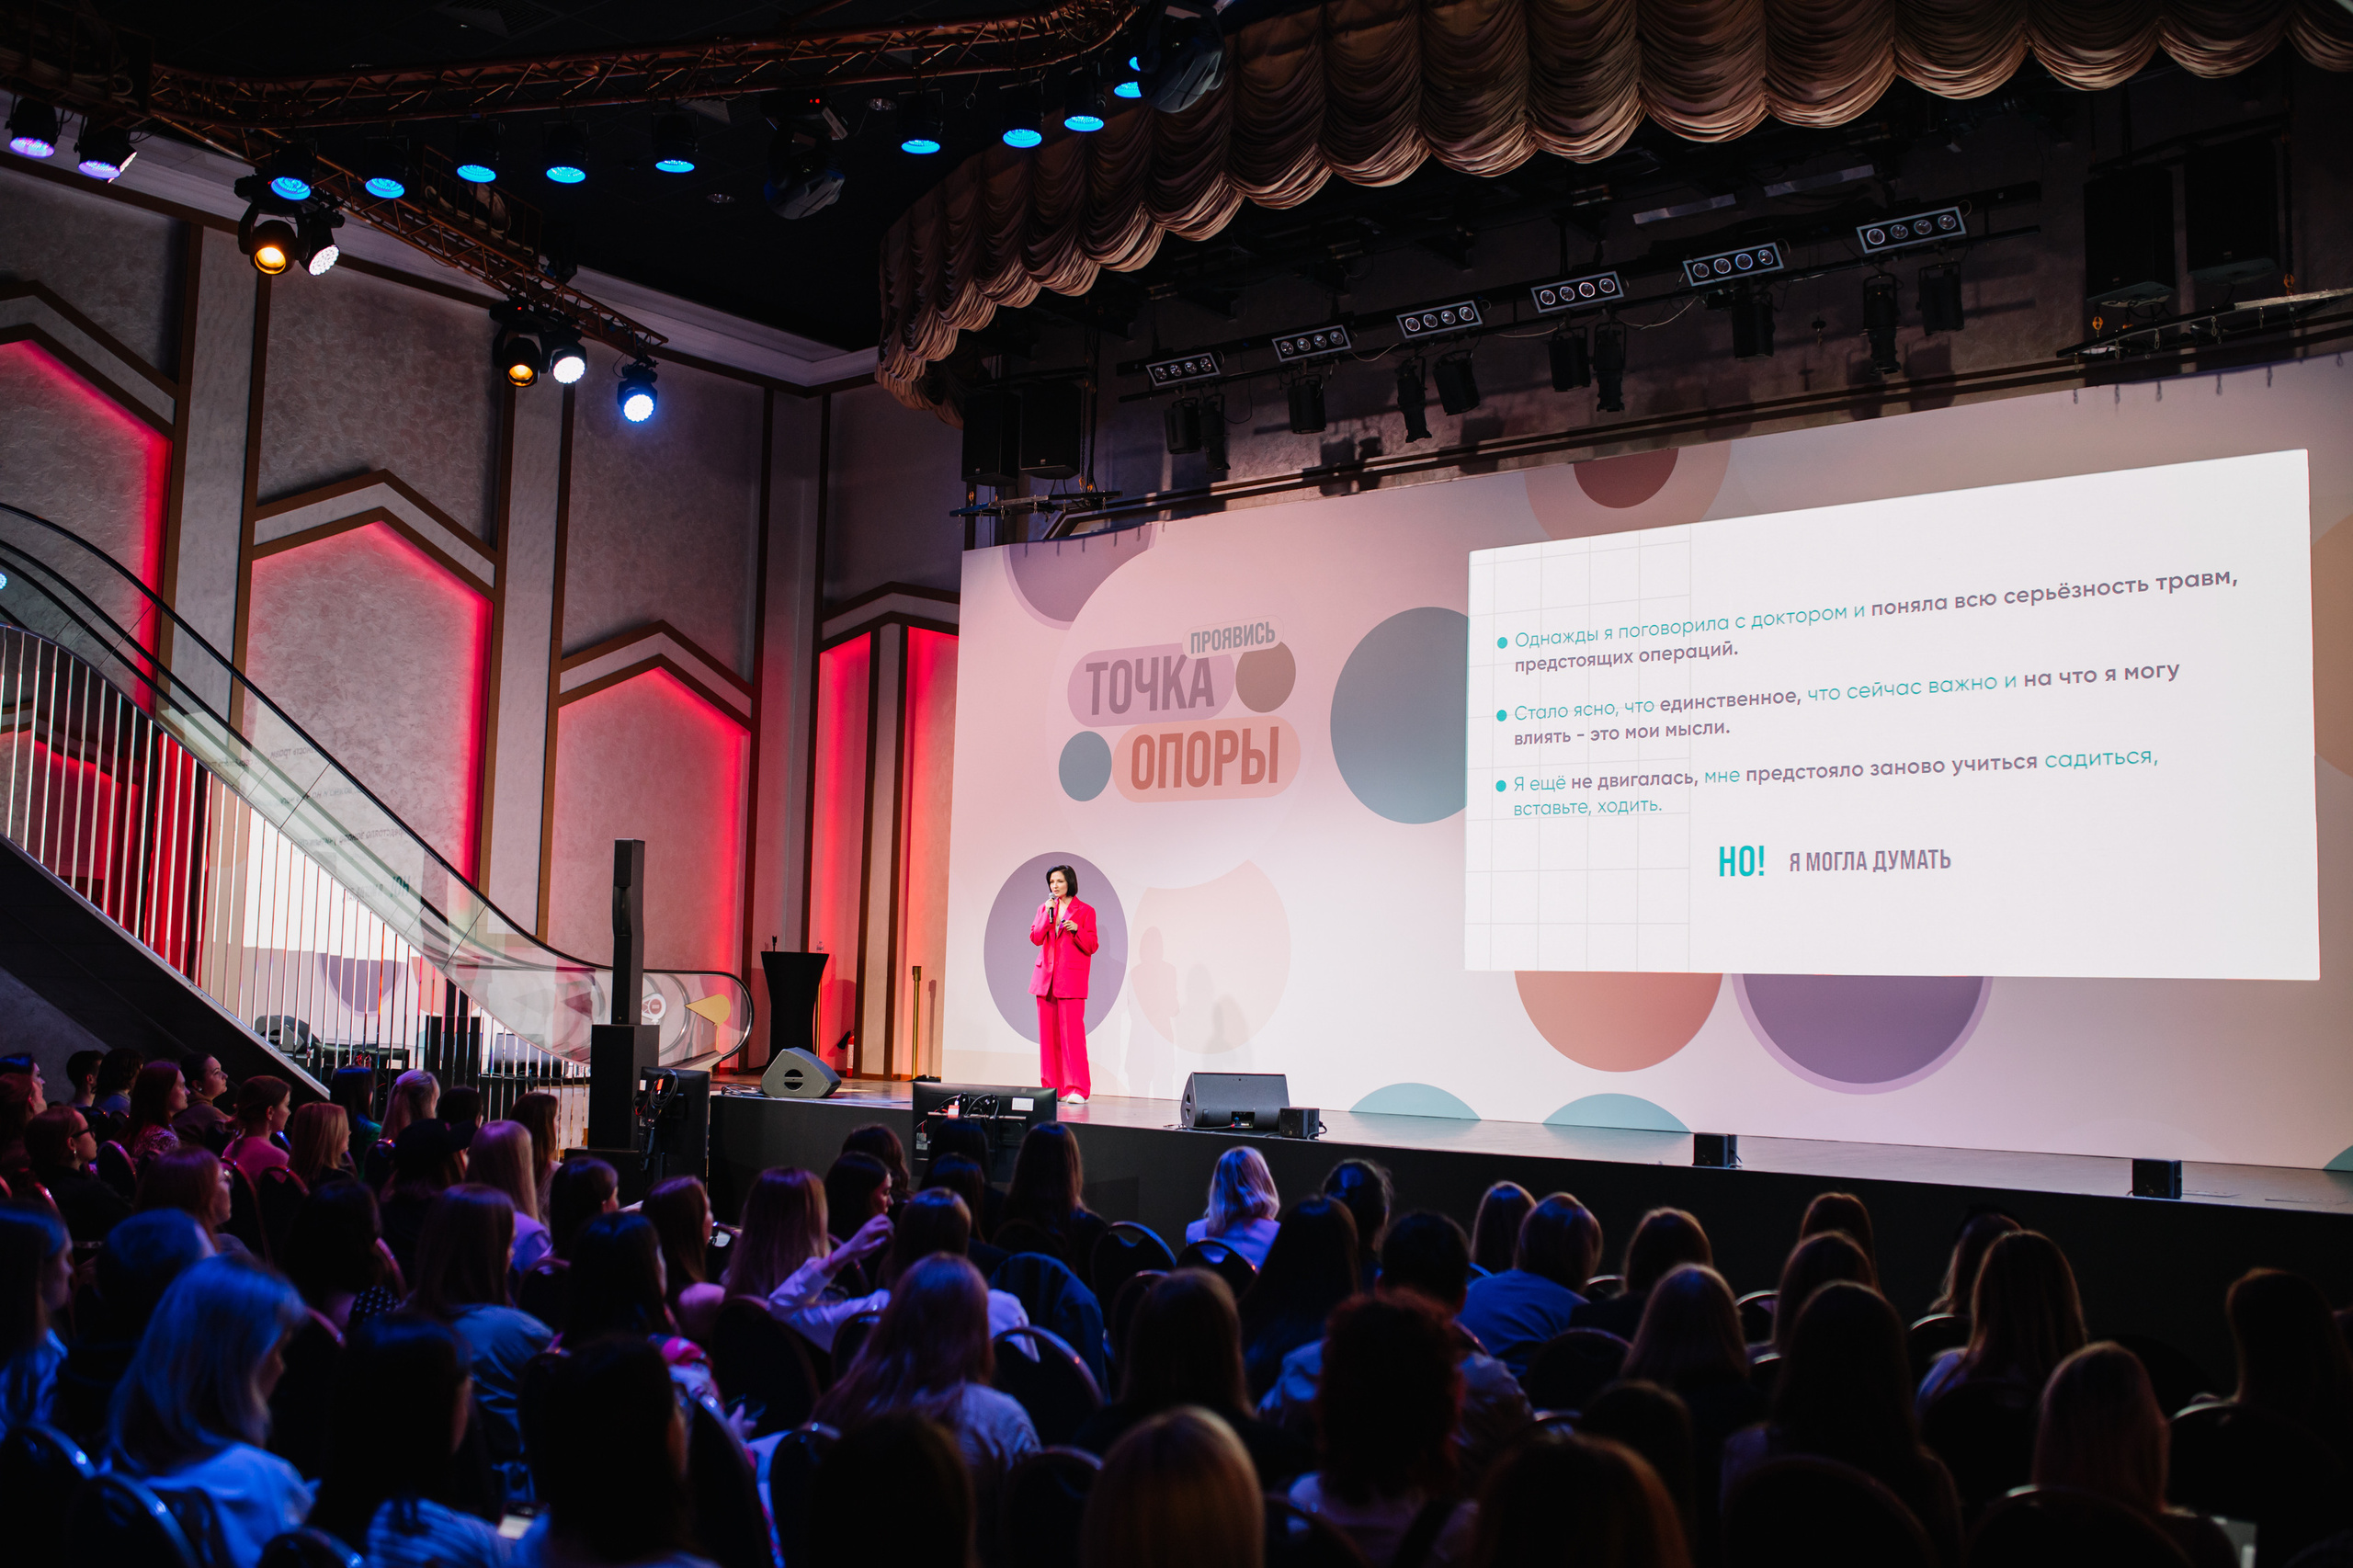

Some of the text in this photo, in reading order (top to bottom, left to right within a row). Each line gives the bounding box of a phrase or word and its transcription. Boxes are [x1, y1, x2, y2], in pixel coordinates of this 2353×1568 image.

[1515, 571, 2237, 648] Однажды я поговорила с доктором и поняла всю серьёзность травм,
[1190, 621, 1276, 654] ПРОЯВИСЬ
[1515, 640, 1737, 675] предстоящих операций.
[1086, 654, 1215, 716] ТОЧКА
[1514, 664, 2179, 721] Стало ясно, что единственное, что сейчас важно и на что я могу
[1514, 732, 1570, 744] влиять
[1589, 728, 1619, 741] это
[1624, 726, 1659, 739] мои
[1665, 722, 1729, 737] мысли.
[1131, 726, 1279, 790] ОПОРЫ
[1514, 750, 2158, 791] Я ещё не двигалась, мне предстояло заново учиться садиться,
[1514, 799, 1662, 815] вставьте, ходить.
[1719, 845, 1951, 877] НО! Я МОГЛА ДУМАТЬ
